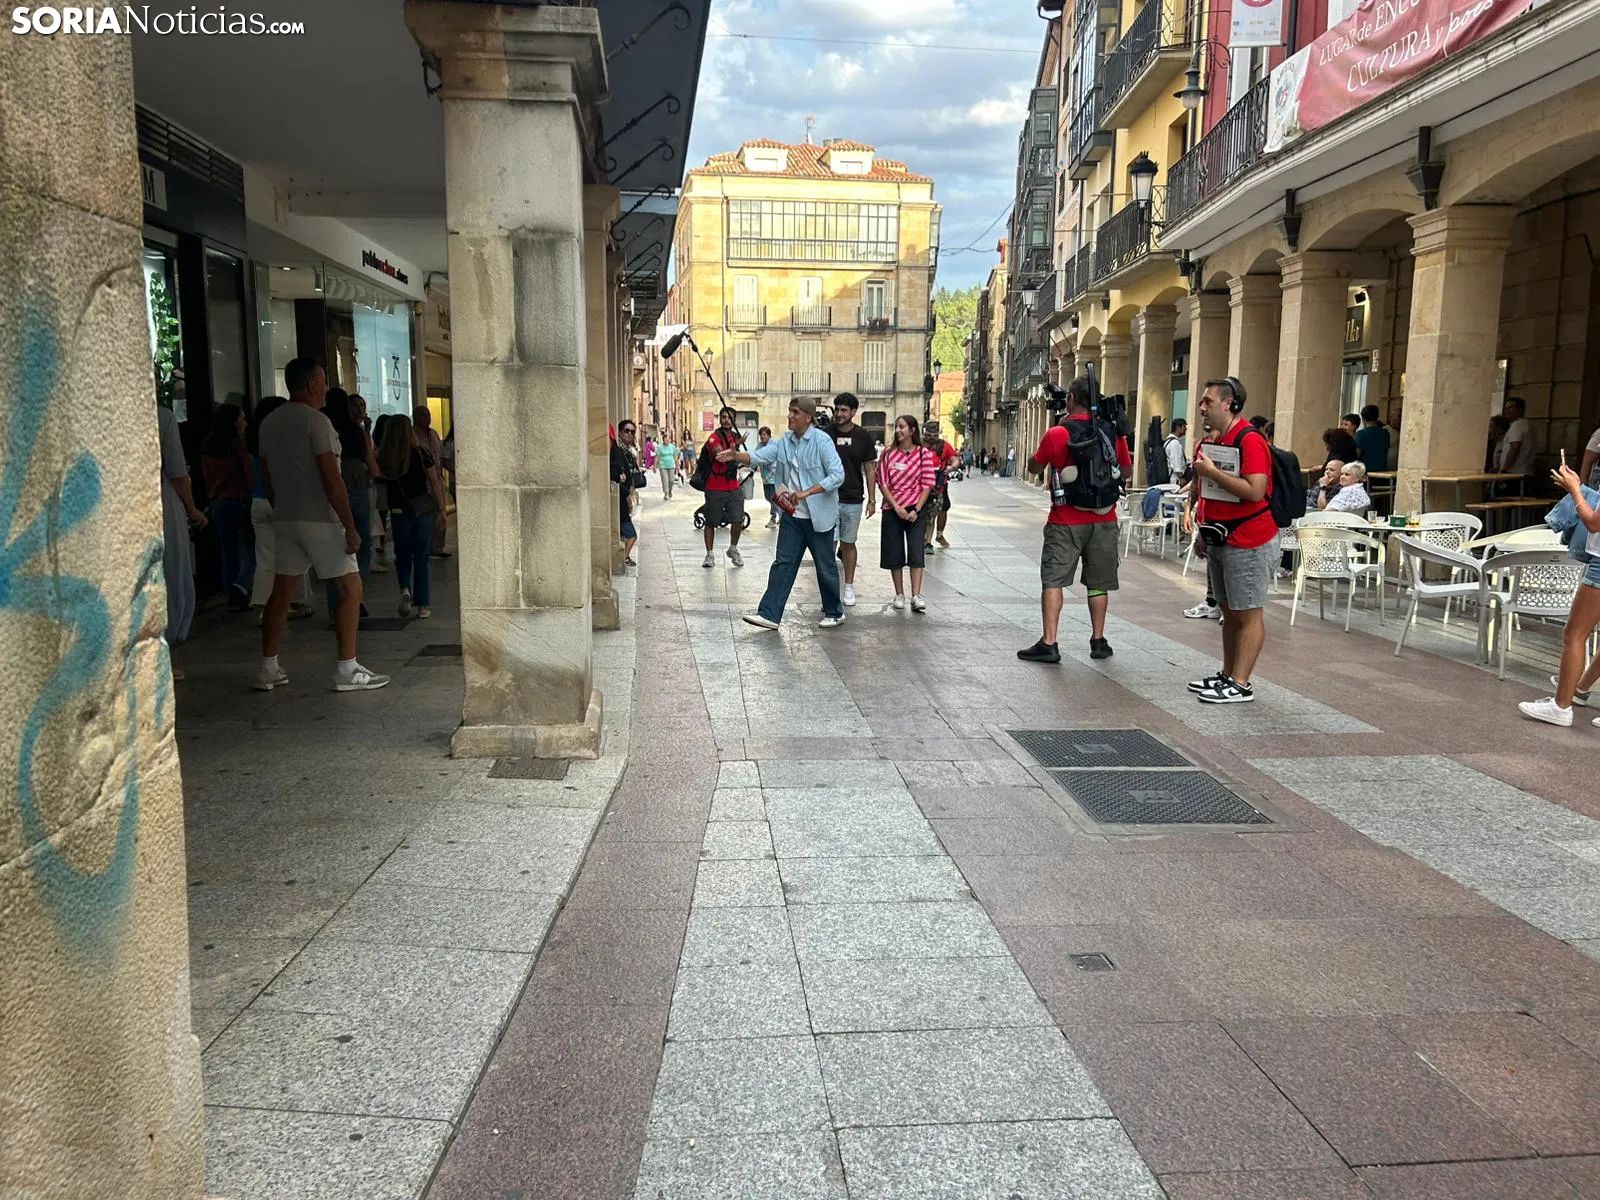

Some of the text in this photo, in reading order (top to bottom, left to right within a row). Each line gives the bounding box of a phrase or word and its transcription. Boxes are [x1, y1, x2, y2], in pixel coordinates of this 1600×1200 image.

[1319, 28, 1358, 66] LUGAR
[1357, 20, 1372, 42] de
[1374, 0, 1420, 33] ENC
[1346, 21, 1431, 92] CULTURA
